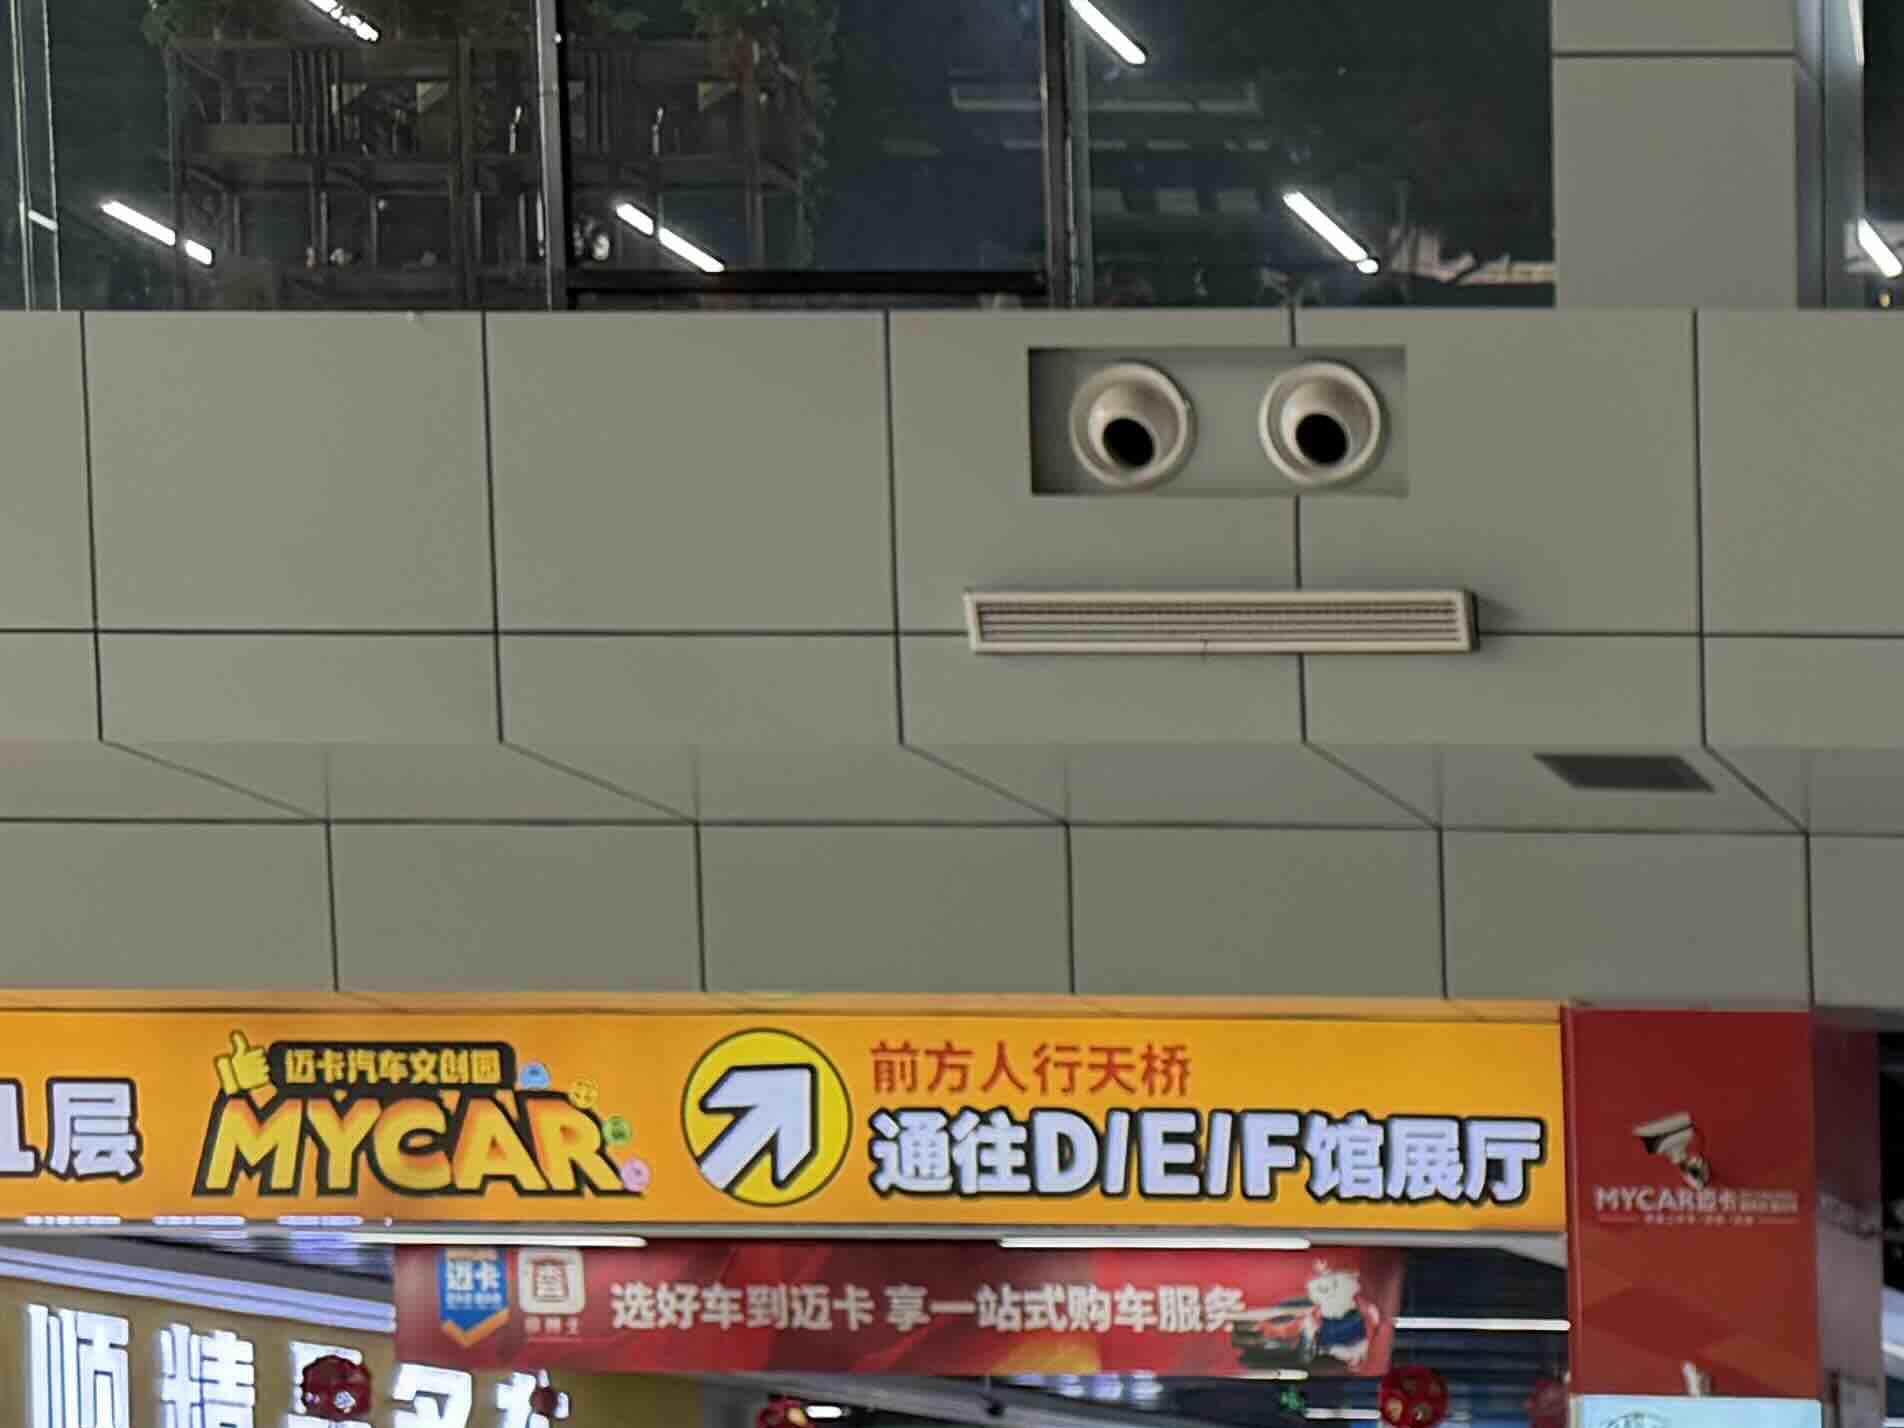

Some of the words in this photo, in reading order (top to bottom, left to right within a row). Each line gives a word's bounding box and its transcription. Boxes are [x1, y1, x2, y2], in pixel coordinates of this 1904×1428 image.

[870, 1041, 1193, 1098] 前方人行天桥
[200, 1093, 638, 1196] MYCAR
[870, 1108, 1543, 1204] 通往D/E/F馆展厅
[610, 1281, 875, 1331] 选好车到迈卡
[886, 1281, 1249, 1334] 享一站式购车服务
